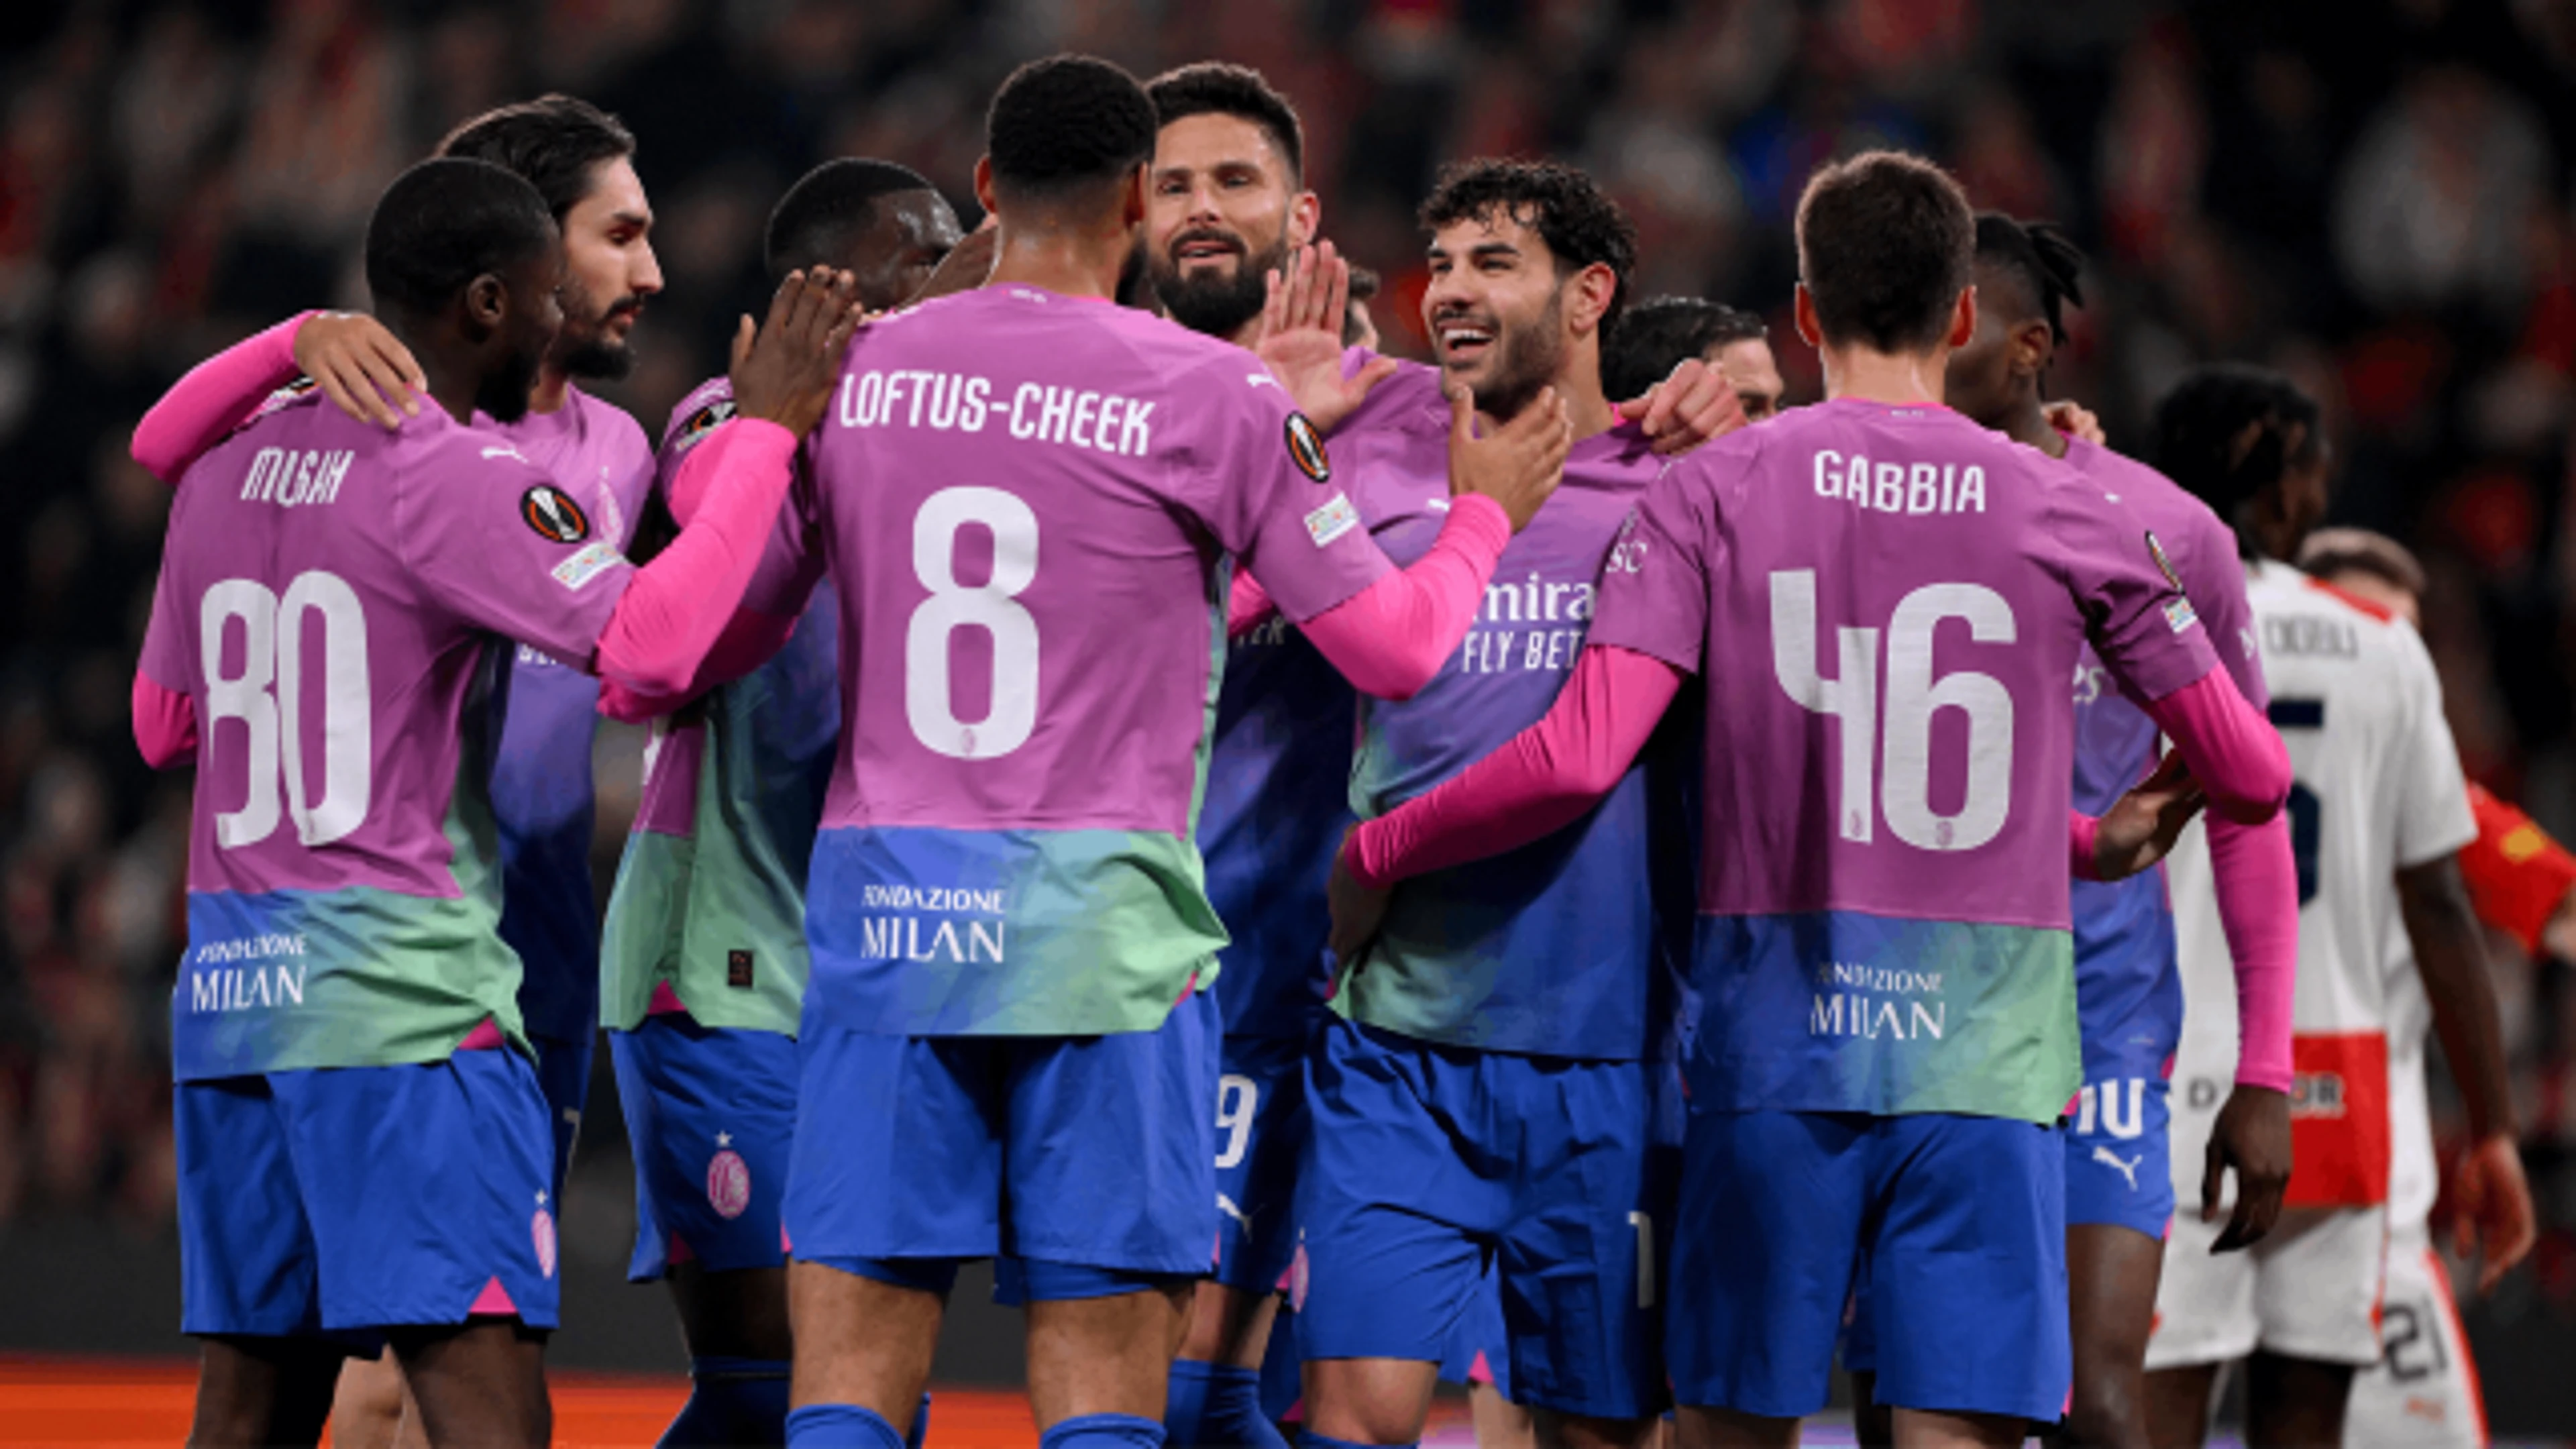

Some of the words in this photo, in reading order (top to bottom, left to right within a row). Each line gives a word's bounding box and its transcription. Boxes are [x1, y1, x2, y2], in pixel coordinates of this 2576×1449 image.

[839, 370, 1155, 457] LOFTUS-CHEEK
[1813, 449, 1986, 515] GABBIA
[906, 486, 1040, 759] 8
[1461, 630, 1514, 673] FLY
[200, 570, 371, 849] 80
[1769, 568, 2017, 851] 46
[861, 917, 1004, 963] MILAN
[192, 965, 306, 1013] MILAN
[1811, 994, 1944, 1040] MILAN
